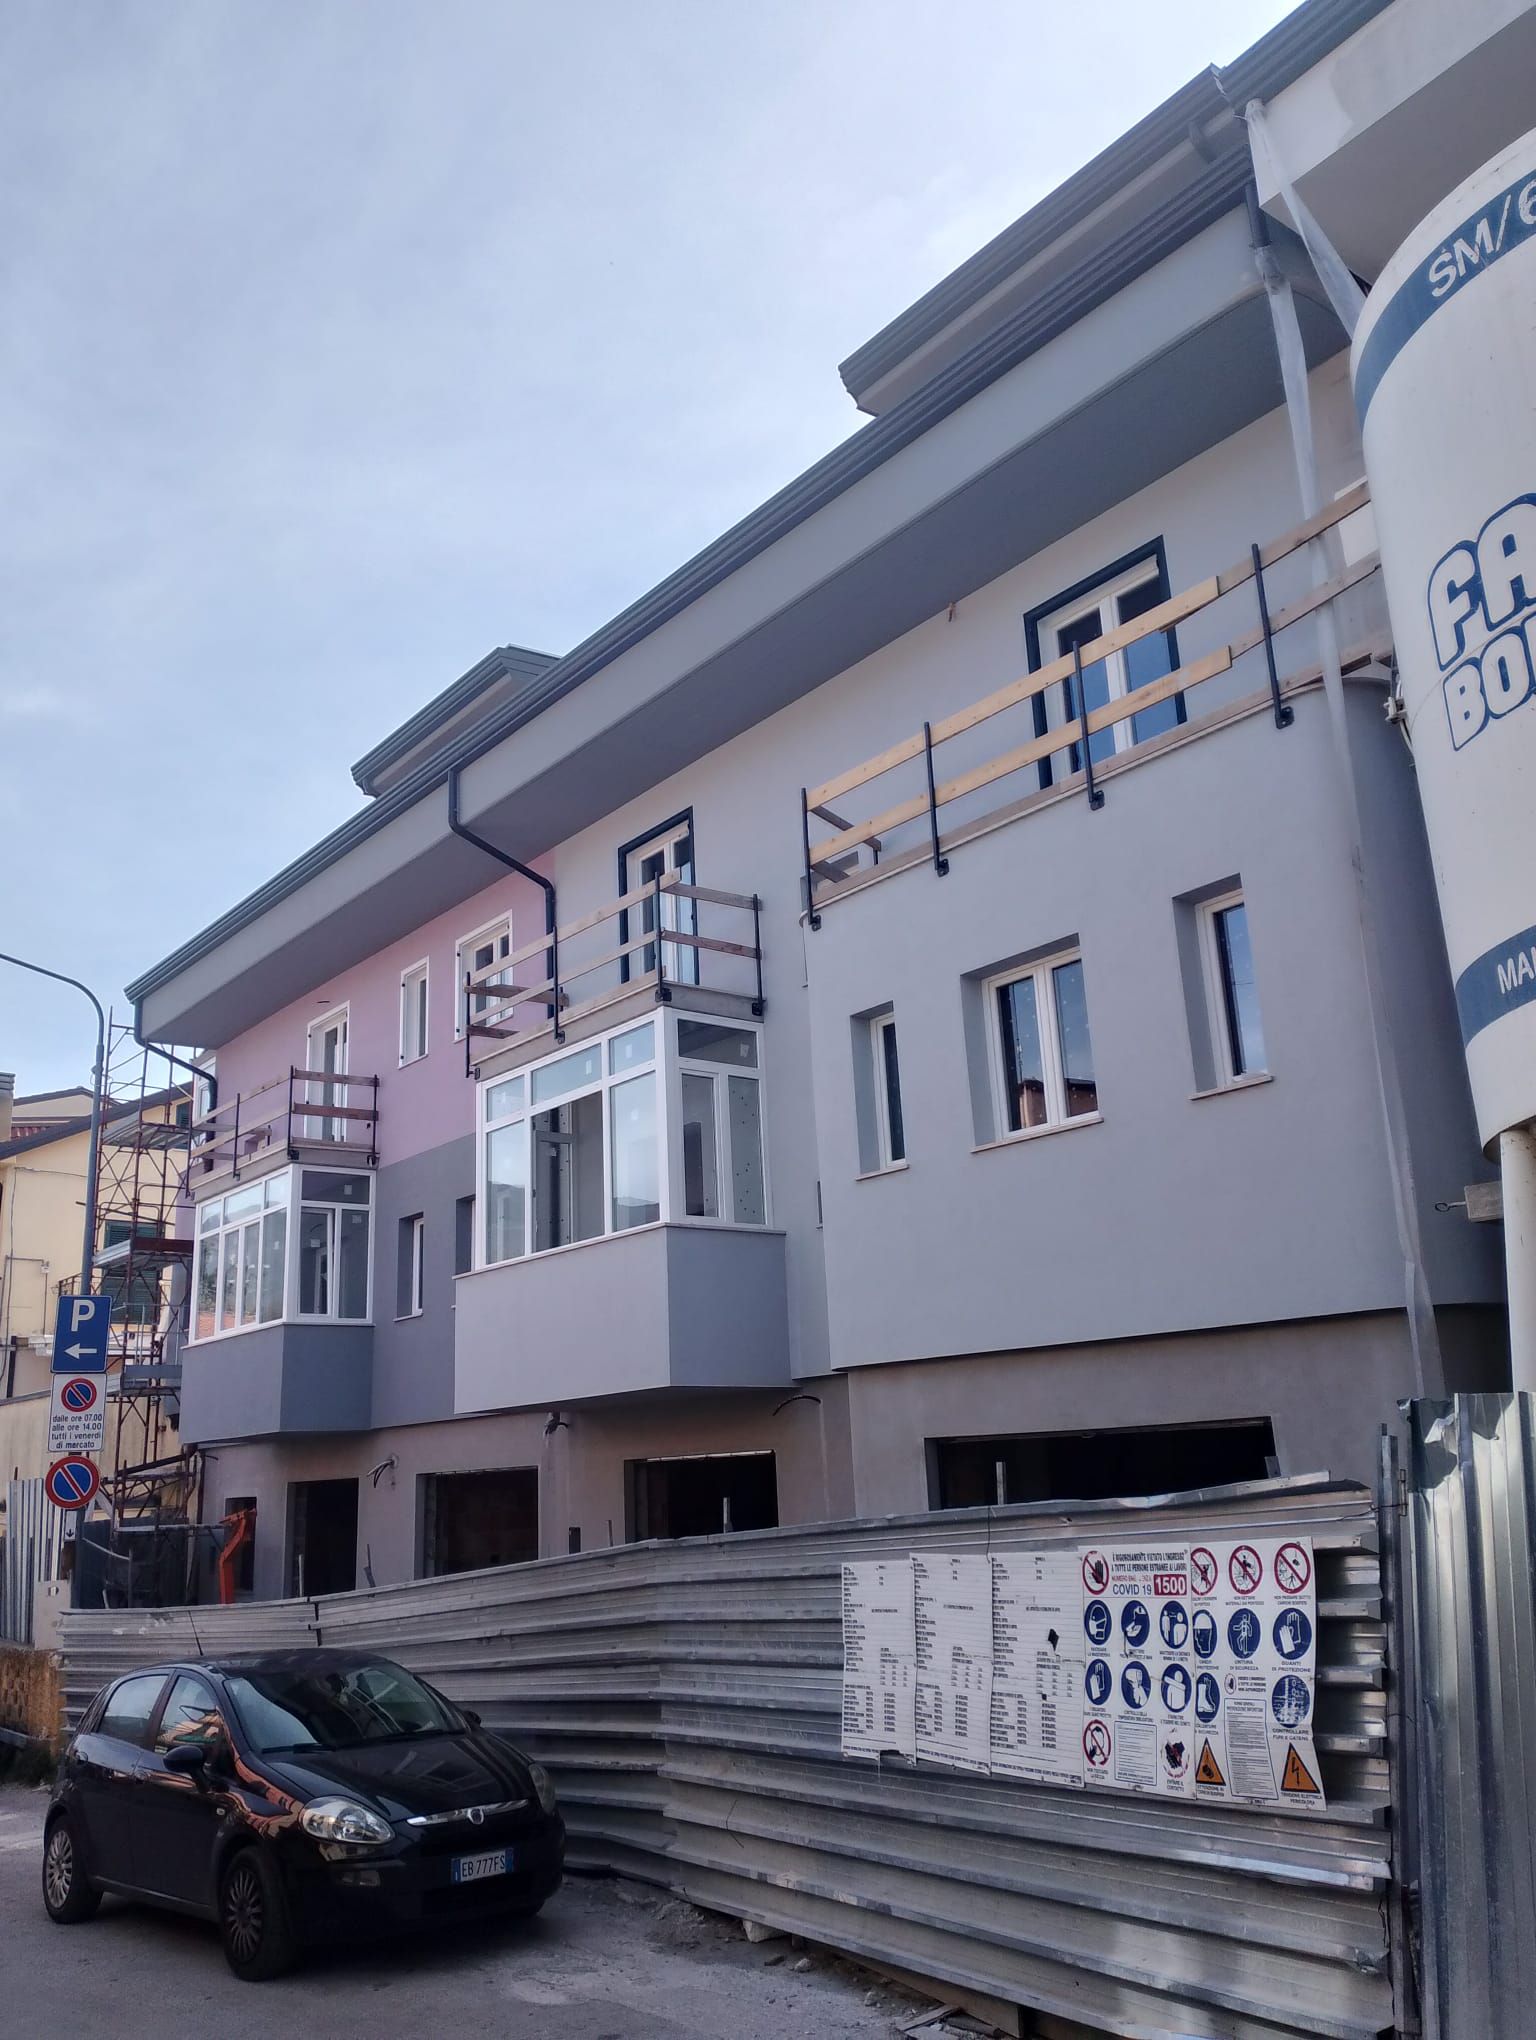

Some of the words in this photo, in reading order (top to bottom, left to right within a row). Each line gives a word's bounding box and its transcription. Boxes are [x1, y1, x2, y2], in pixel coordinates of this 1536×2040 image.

[70, 1299, 96, 1332] P
[52, 1414, 69, 1423] dalle
[84, 1413, 103, 1422] 07.00
[52, 1423, 66, 1431] alle
[82, 1422, 102, 1431] 14.00
[51, 1432, 67, 1440] tutti
[56, 1441, 63, 1449] di
[65, 1441, 95, 1449] mercato
[1112, 1584, 1140, 1595] COVID
[1142, 1584, 1152, 1595] 19
[1155, 1576, 1186, 1594] 1500
[461, 1861, 474, 1877] EB
[476, 1855, 505, 1874] 777FS
